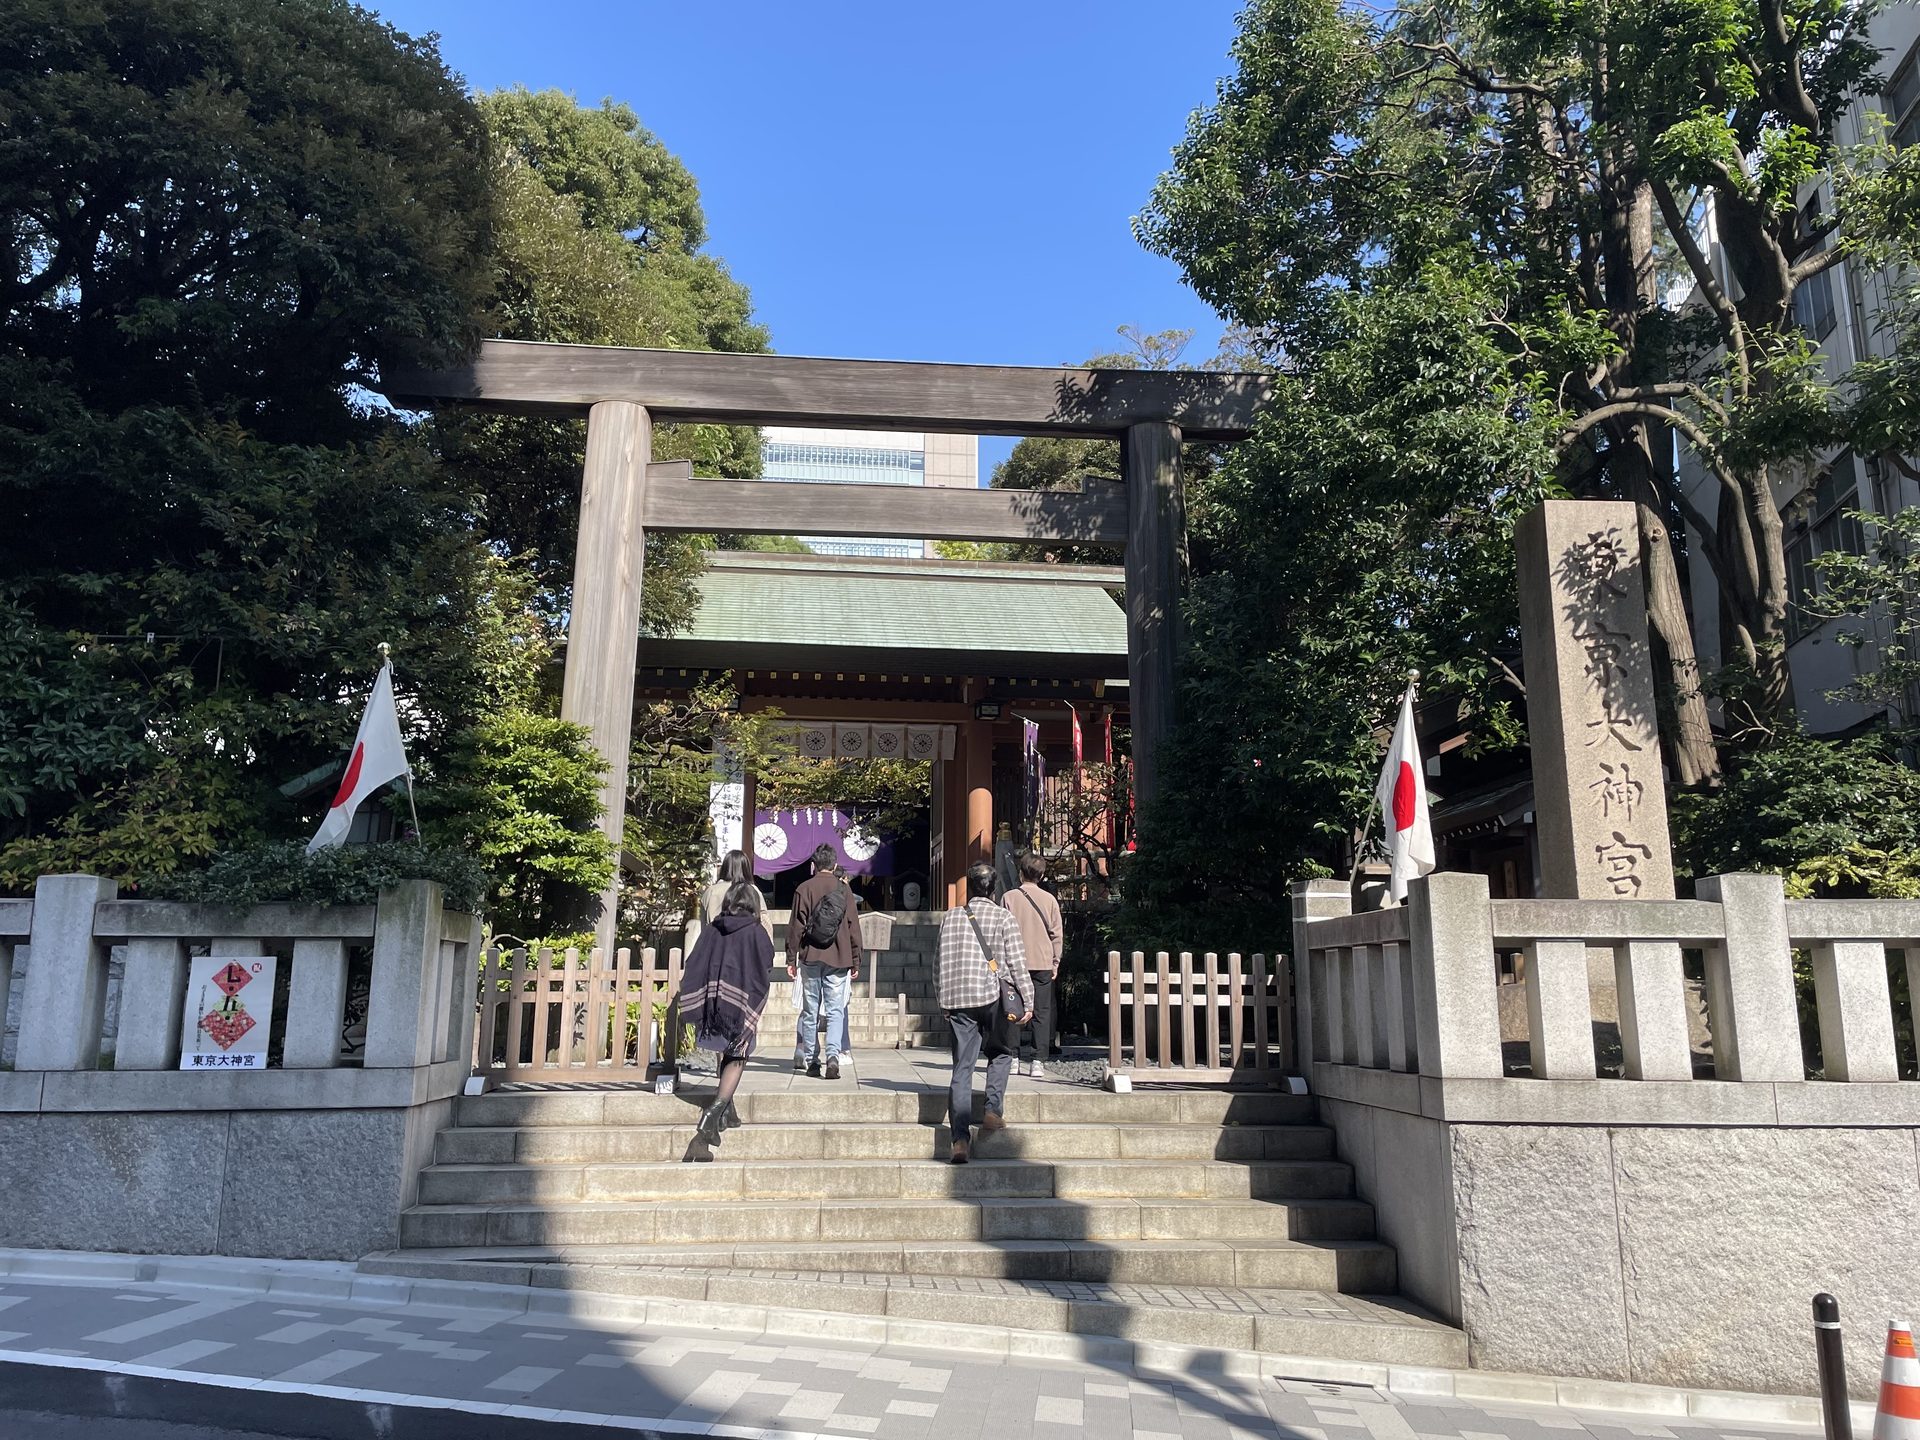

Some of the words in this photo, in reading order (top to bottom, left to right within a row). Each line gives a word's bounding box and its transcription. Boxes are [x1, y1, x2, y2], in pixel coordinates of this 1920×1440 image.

[1572, 531, 1652, 897] 東京大神宮
[192, 1055, 255, 1066] 東京大神宮
